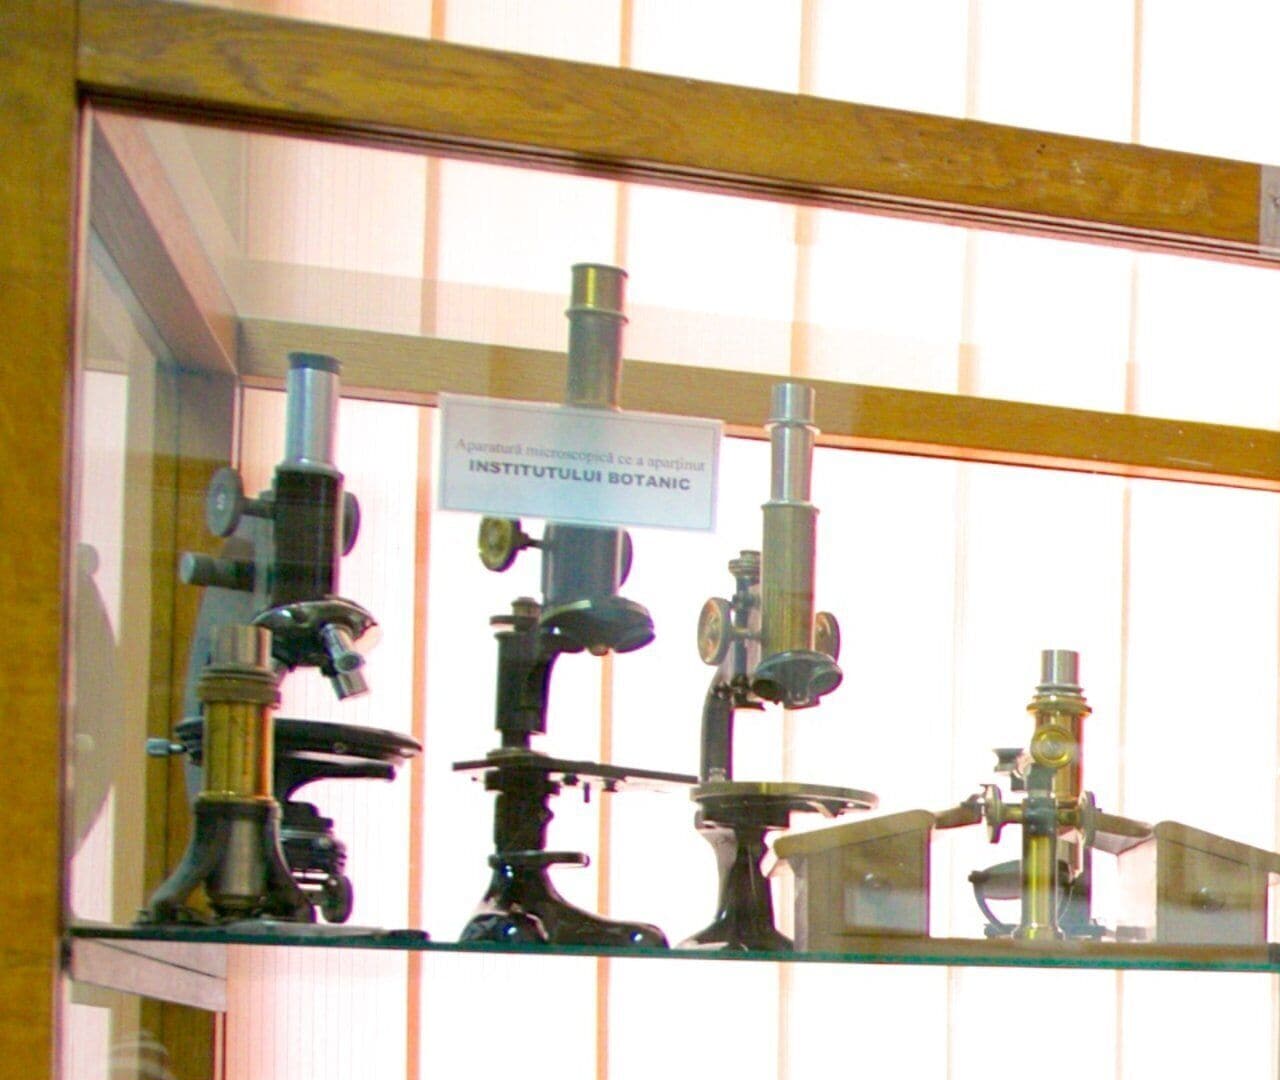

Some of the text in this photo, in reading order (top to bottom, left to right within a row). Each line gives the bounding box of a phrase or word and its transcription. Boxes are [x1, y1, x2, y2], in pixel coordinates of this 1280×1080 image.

[456, 437, 523, 458] Aparatură
[469, 459, 691, 491] INSTITUTULUI BOTANIC
